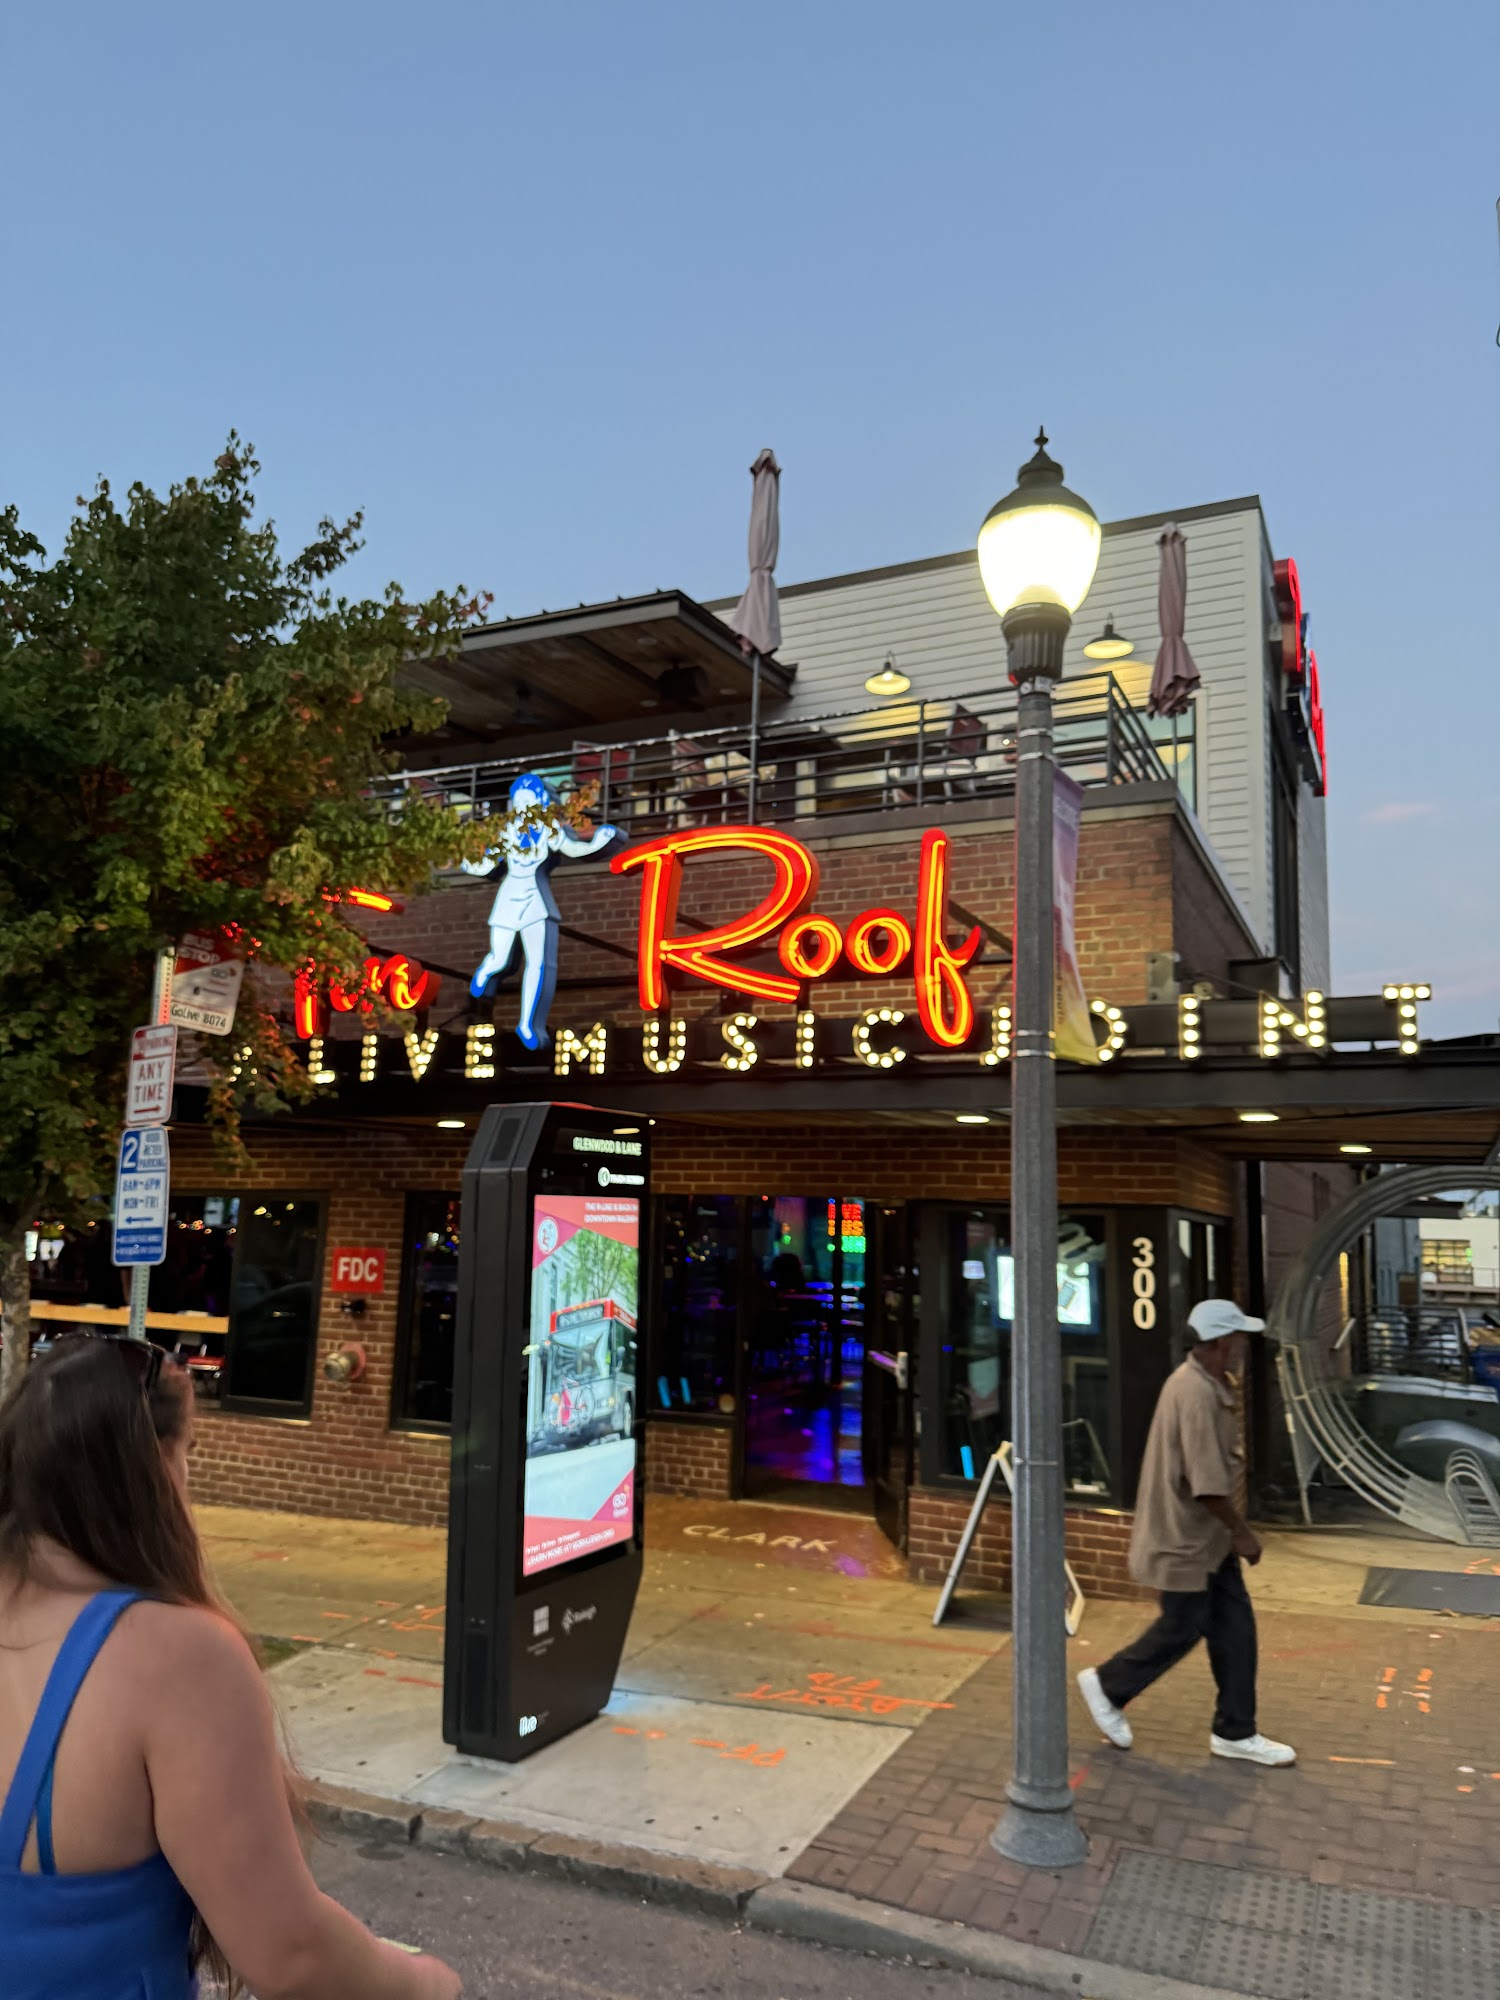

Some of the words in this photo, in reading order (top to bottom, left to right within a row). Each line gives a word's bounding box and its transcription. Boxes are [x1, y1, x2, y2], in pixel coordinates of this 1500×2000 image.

[610, 825, 982, 1047] Roof
[177, 946, 221, 964] STOP
[171, 1005, 200, 1021] GoLive
[203, 1014, 226, 1028] 8074
[308, 1023, 496, 1084] LIVE
[554, 1006, 907, 1076] MUSIC
[139, 1060, 166, 1081] ANY
[134, 1082, 166, 1103] TIME
[122, 1136, 138, 1169] 2
[572, 1136, 615, 1154] GLENWOOD
[621, 1141, 642, 1156] LANE
[337, 1256, 379, 1282] FDC
[1131, 1236, 1157, 1331] 300
[682, 1524, 838, 1553] CLARK
